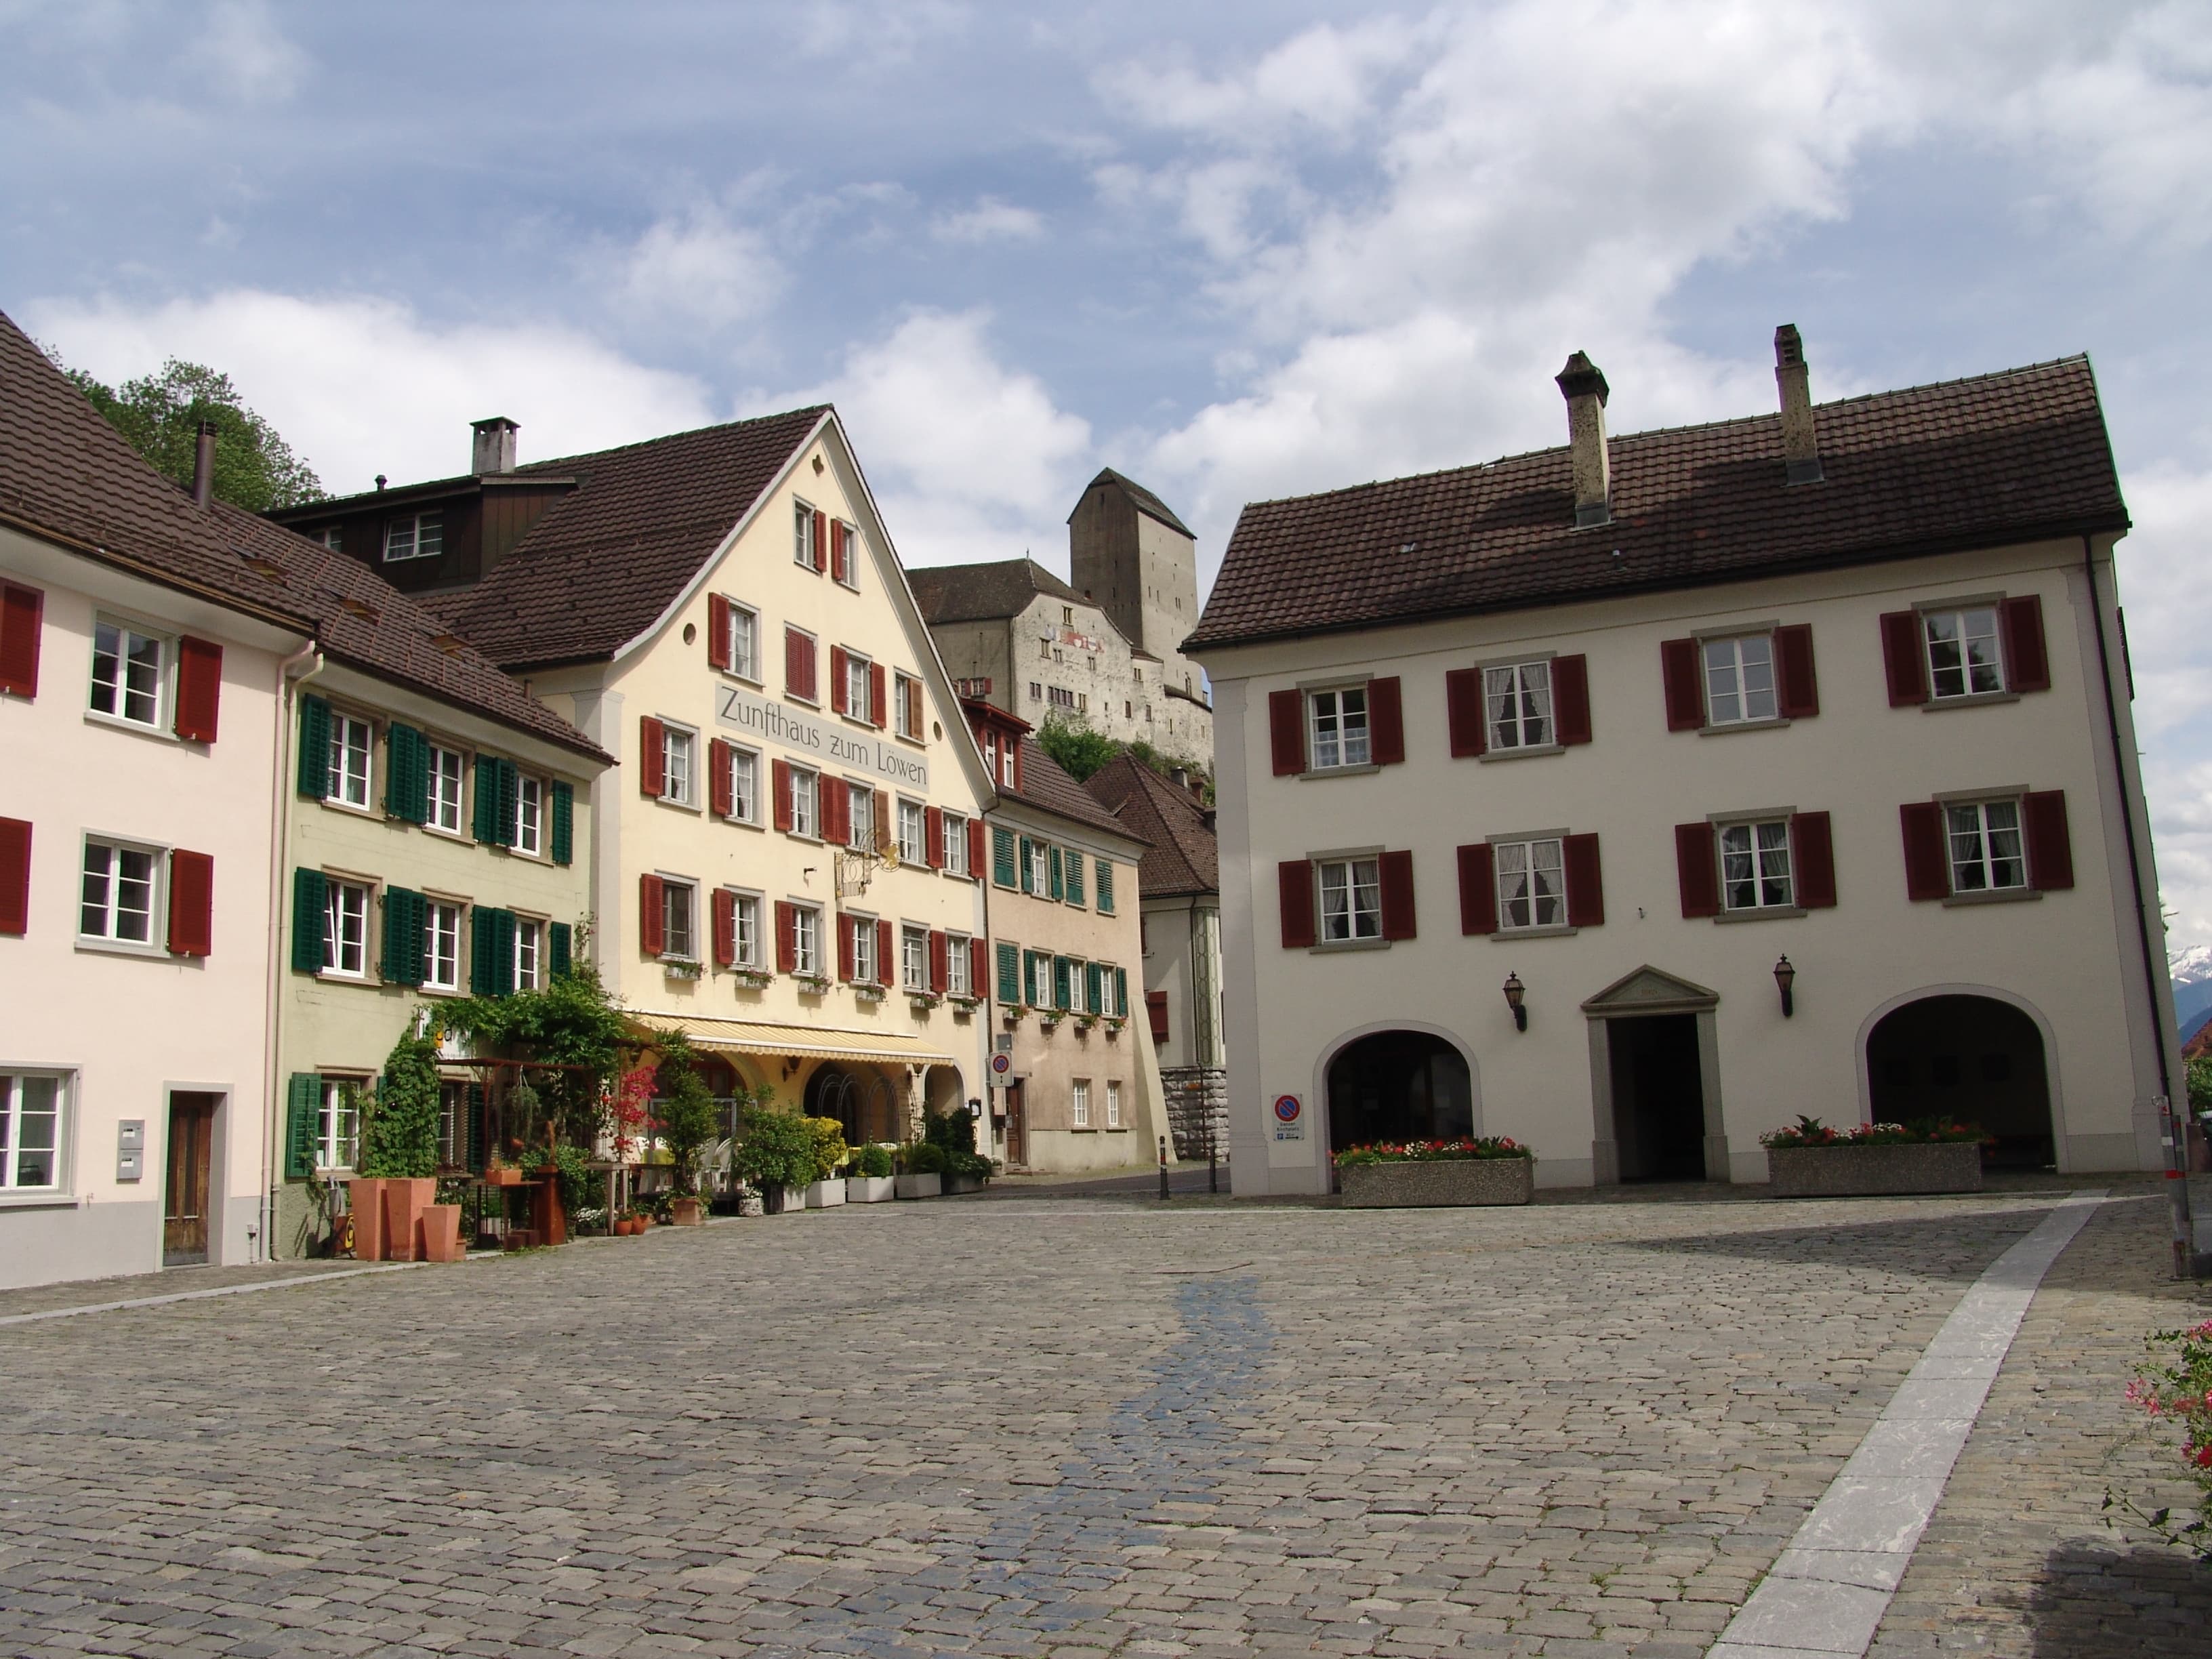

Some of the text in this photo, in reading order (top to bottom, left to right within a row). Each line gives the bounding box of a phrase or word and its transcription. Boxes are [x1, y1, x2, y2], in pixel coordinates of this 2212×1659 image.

[721, 686, 926, 785] Zunfthaus zum Löwen
